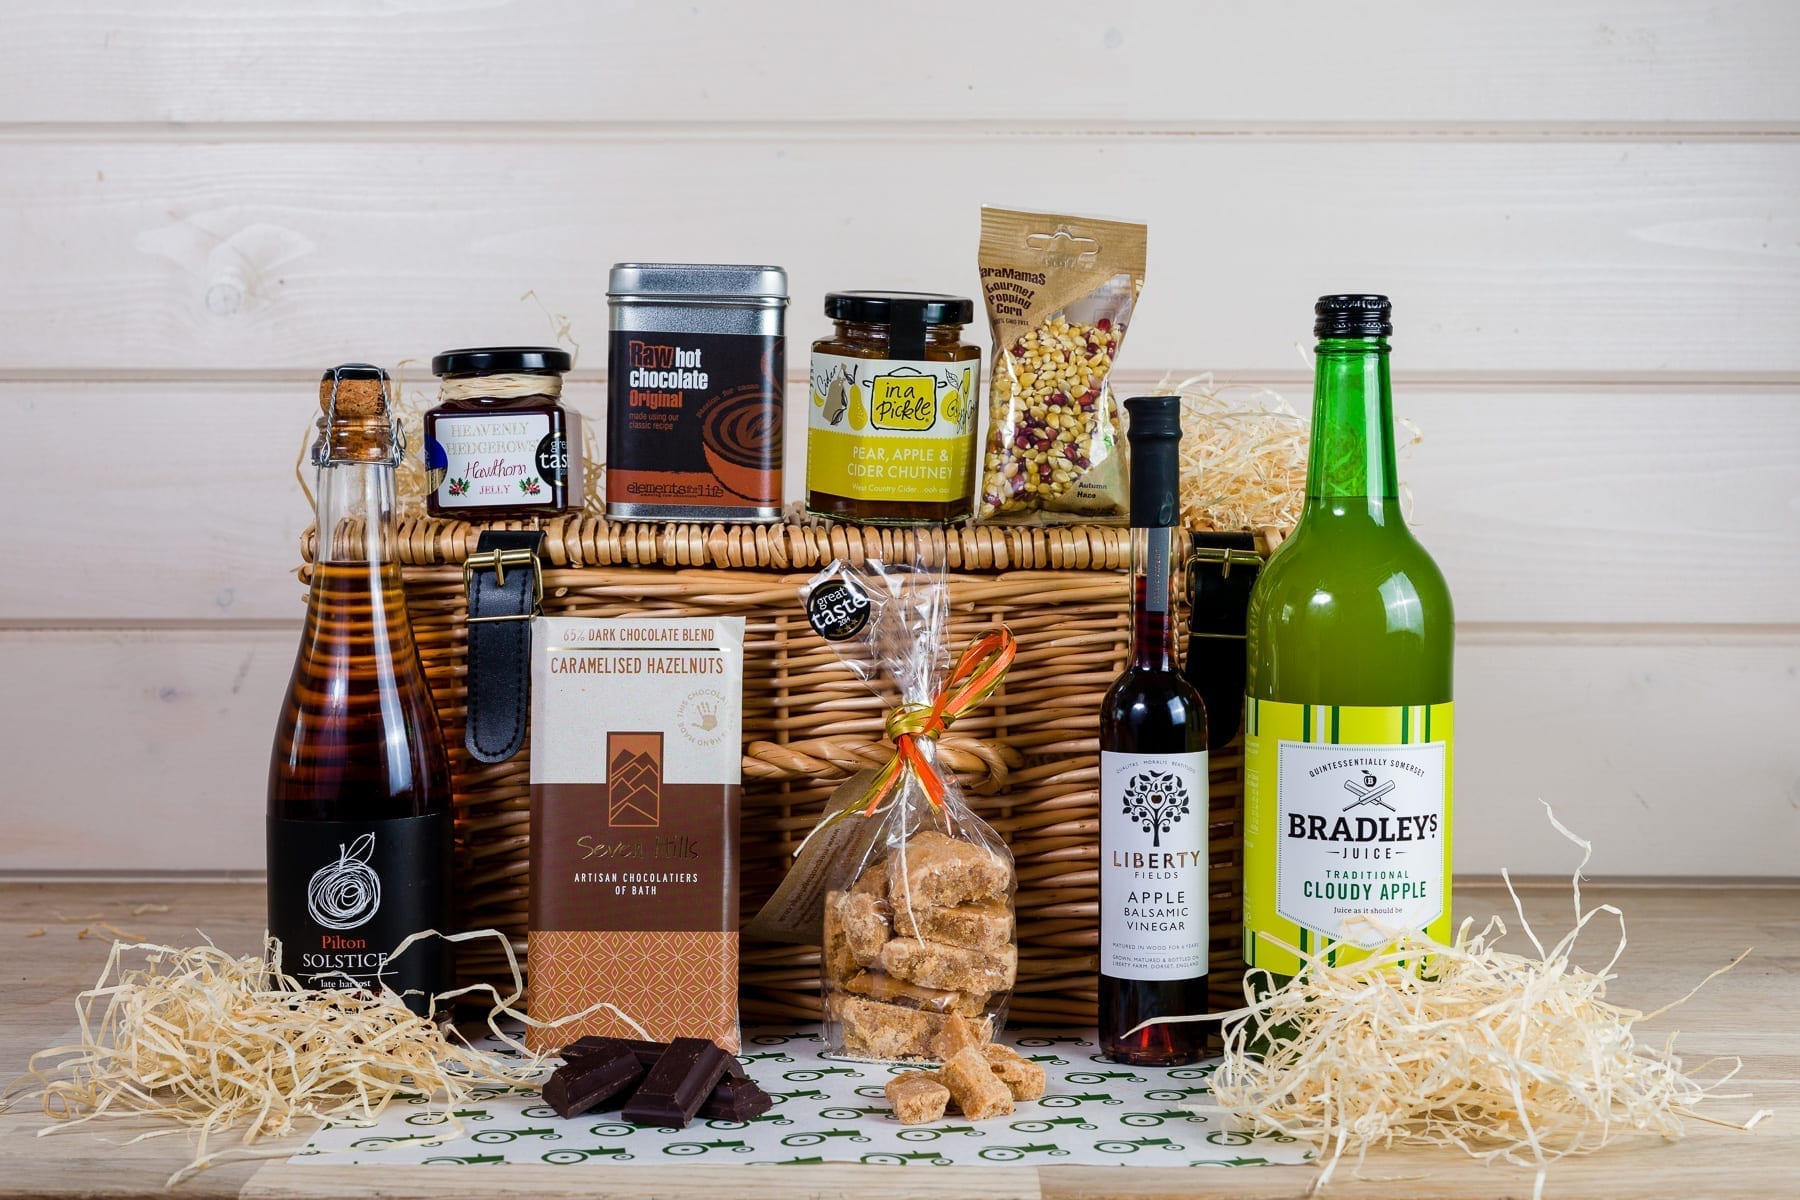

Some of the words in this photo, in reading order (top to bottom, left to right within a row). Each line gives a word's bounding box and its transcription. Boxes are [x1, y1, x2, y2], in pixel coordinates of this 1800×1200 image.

[979, 266, 1046, 285] araMamaS
[985, 282, 1035, 299] Gourmet
[988, 294, 1032, 310] Popping
[996, 303, 1022, 316] Corn
[629, 340, 674, 368] Raw
[675, 347, 701, 368] hot
[629, 367, 709, 390] chocolate
[817, 365, 837, 396] Cider
[885, 382, 899, 398] in
[904, 387, 915, 398] a
[629, 389, 683, 410] Original
[629, 412, 647, 420] made
[649, 413, 666, 422] using
[450, 422, 529, 438] HEAVENLY
[629, 421, 651, 430] classic
[653, 423, 673, 431] recipe
[551, 441, 567, 453] gre
[853, 446, 889, 463] PEAR,
[892, 448, 934, 462] APPLE
[939, 449, 949, 462] &
[464, 458, 526, 479] Hawthorn
[539, 452, 568, 469] tas
[847, 463, 884, 478] CIDER
[887, 466, 953, 480] CHUTNEY
[480, 484, 510, 495] JELLY
[852, 483, 867, 491] West
[868, 484, 896, 493] Country
[1078, 482, 1107, 490] Autumn
[816, 586, 848, 610] great
[811, 594, 868, 629] taste
[563, 629, 585, 642] 65%
[588, 628, 616, 642] DARK
[620, 628, 680, 642] CHOCOLATE
[682, 628, 715, 642] BLEND
[551, 657, 642, 675] CARAMELISED
[647, 657, 724, 675] HAZELNUTS
[1309, 758, 1387, 778] QUINTESSENTIALLY
[1390, 759, 1425, 778] SOMERSET
[577, 835, 643, 860] Seven
[655, 835, 699, 860] Hills
[1342, 847, 1392, 860] JUICE
[1112, 850, 1200, 869] LIBERTY
[574, 873, 617, 883] ARTISAN
[622, 873, 698, 883] CHOCOLATIERS
[1135, 871, 1178, 880] FIELDS
[1326, 870, 1409, 880] TRADITIONAL
[615, 886, 626, 896] OF
[632, 886, 657, 896] BATH
[1128, 891, 1185, 904] APPLE
[1303, 880, 1372, 901] CLOUDY
[1380, 881, 1426, 901] APPLE
[1124, 907, 1189, 918] BALSAMIC
[1333, 906, 1352, 915] Juice
[1363, 906, 1369, 914] it
[1370, 906, 1394, 914] should
[1126, 921, 1185, 932] VINEGAR
[322, 935, 366, 949] Pilton
[302, 952, 389, 969] SOLSTICE
[320, 979, 336, 988] late
